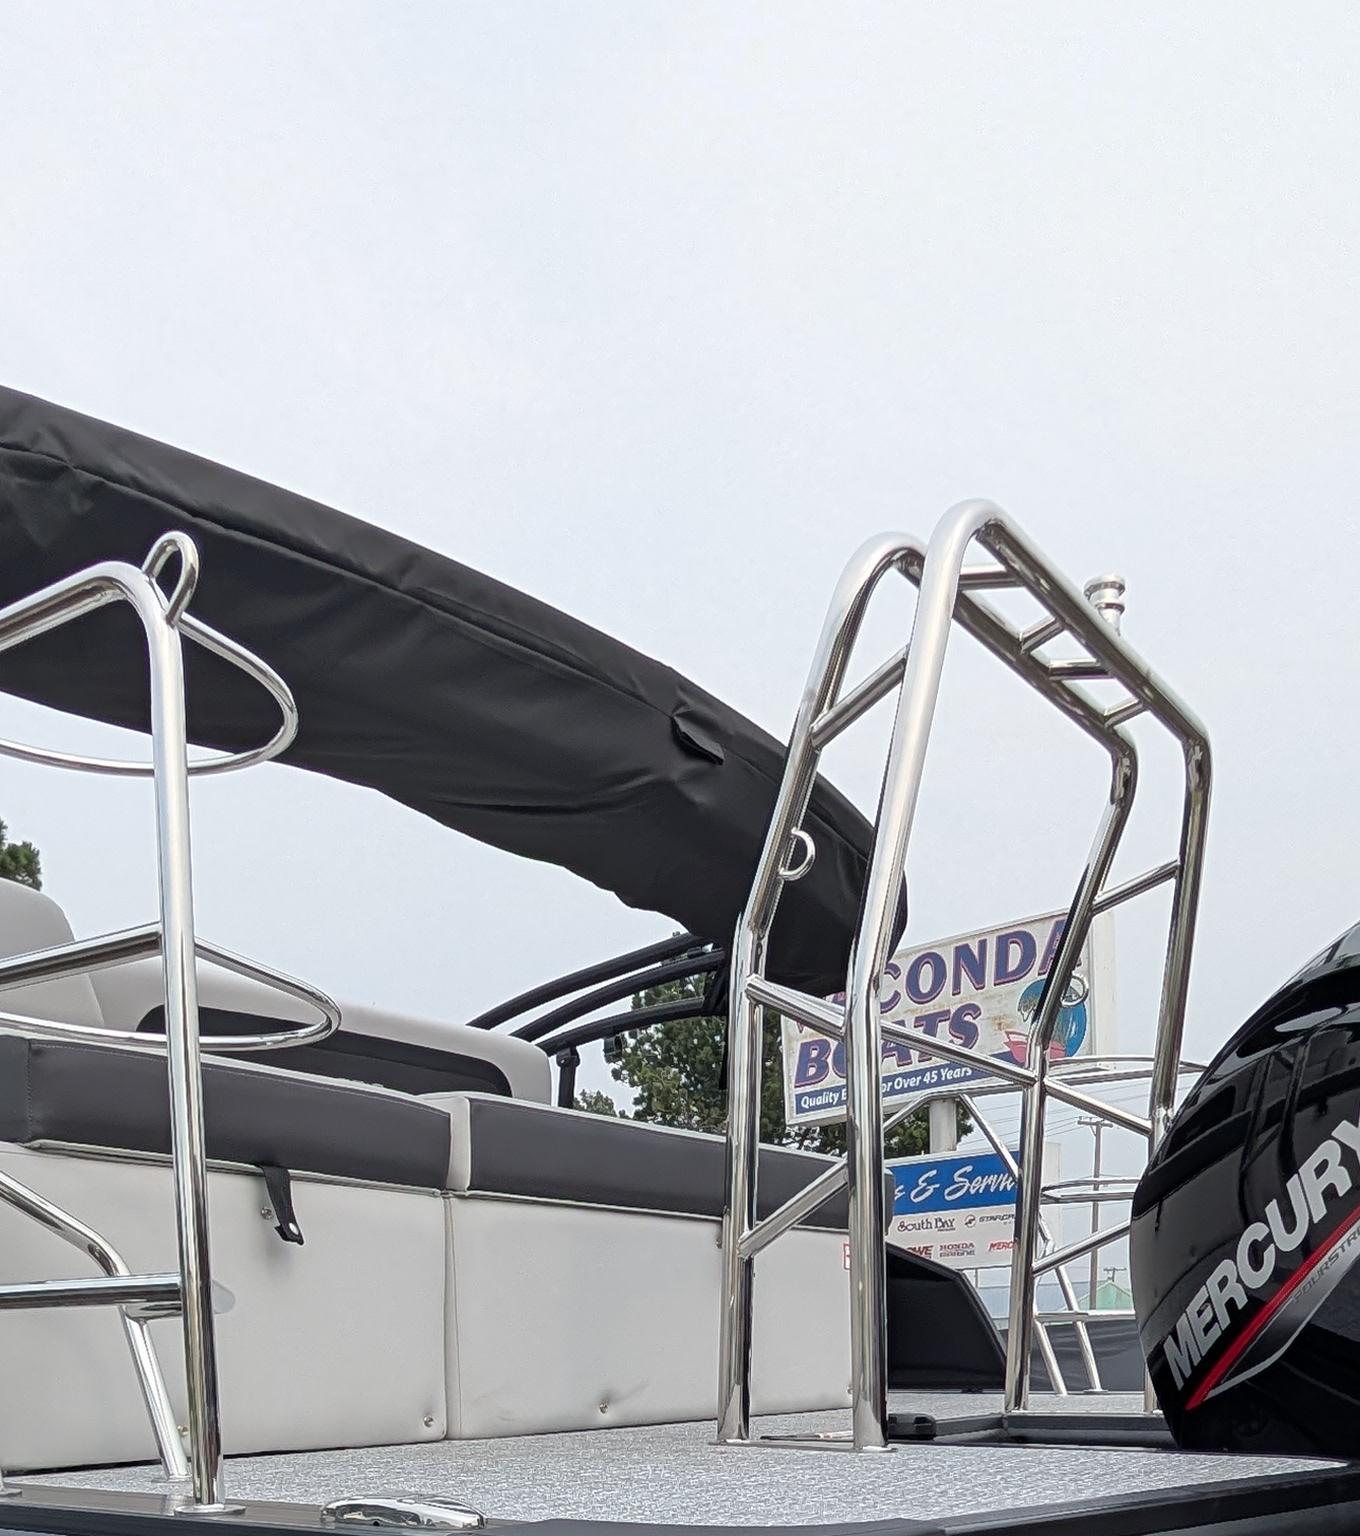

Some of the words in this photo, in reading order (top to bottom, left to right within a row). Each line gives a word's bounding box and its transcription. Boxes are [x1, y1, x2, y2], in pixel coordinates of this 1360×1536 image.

[800, 1091, 840, 1110] Quality
[894, 1074, 922, 1091] Over
[922, 1069, 939, 1083] 45
[939, 1065, 973, 1082] Years
[897, 1218, 933, 1232] South
